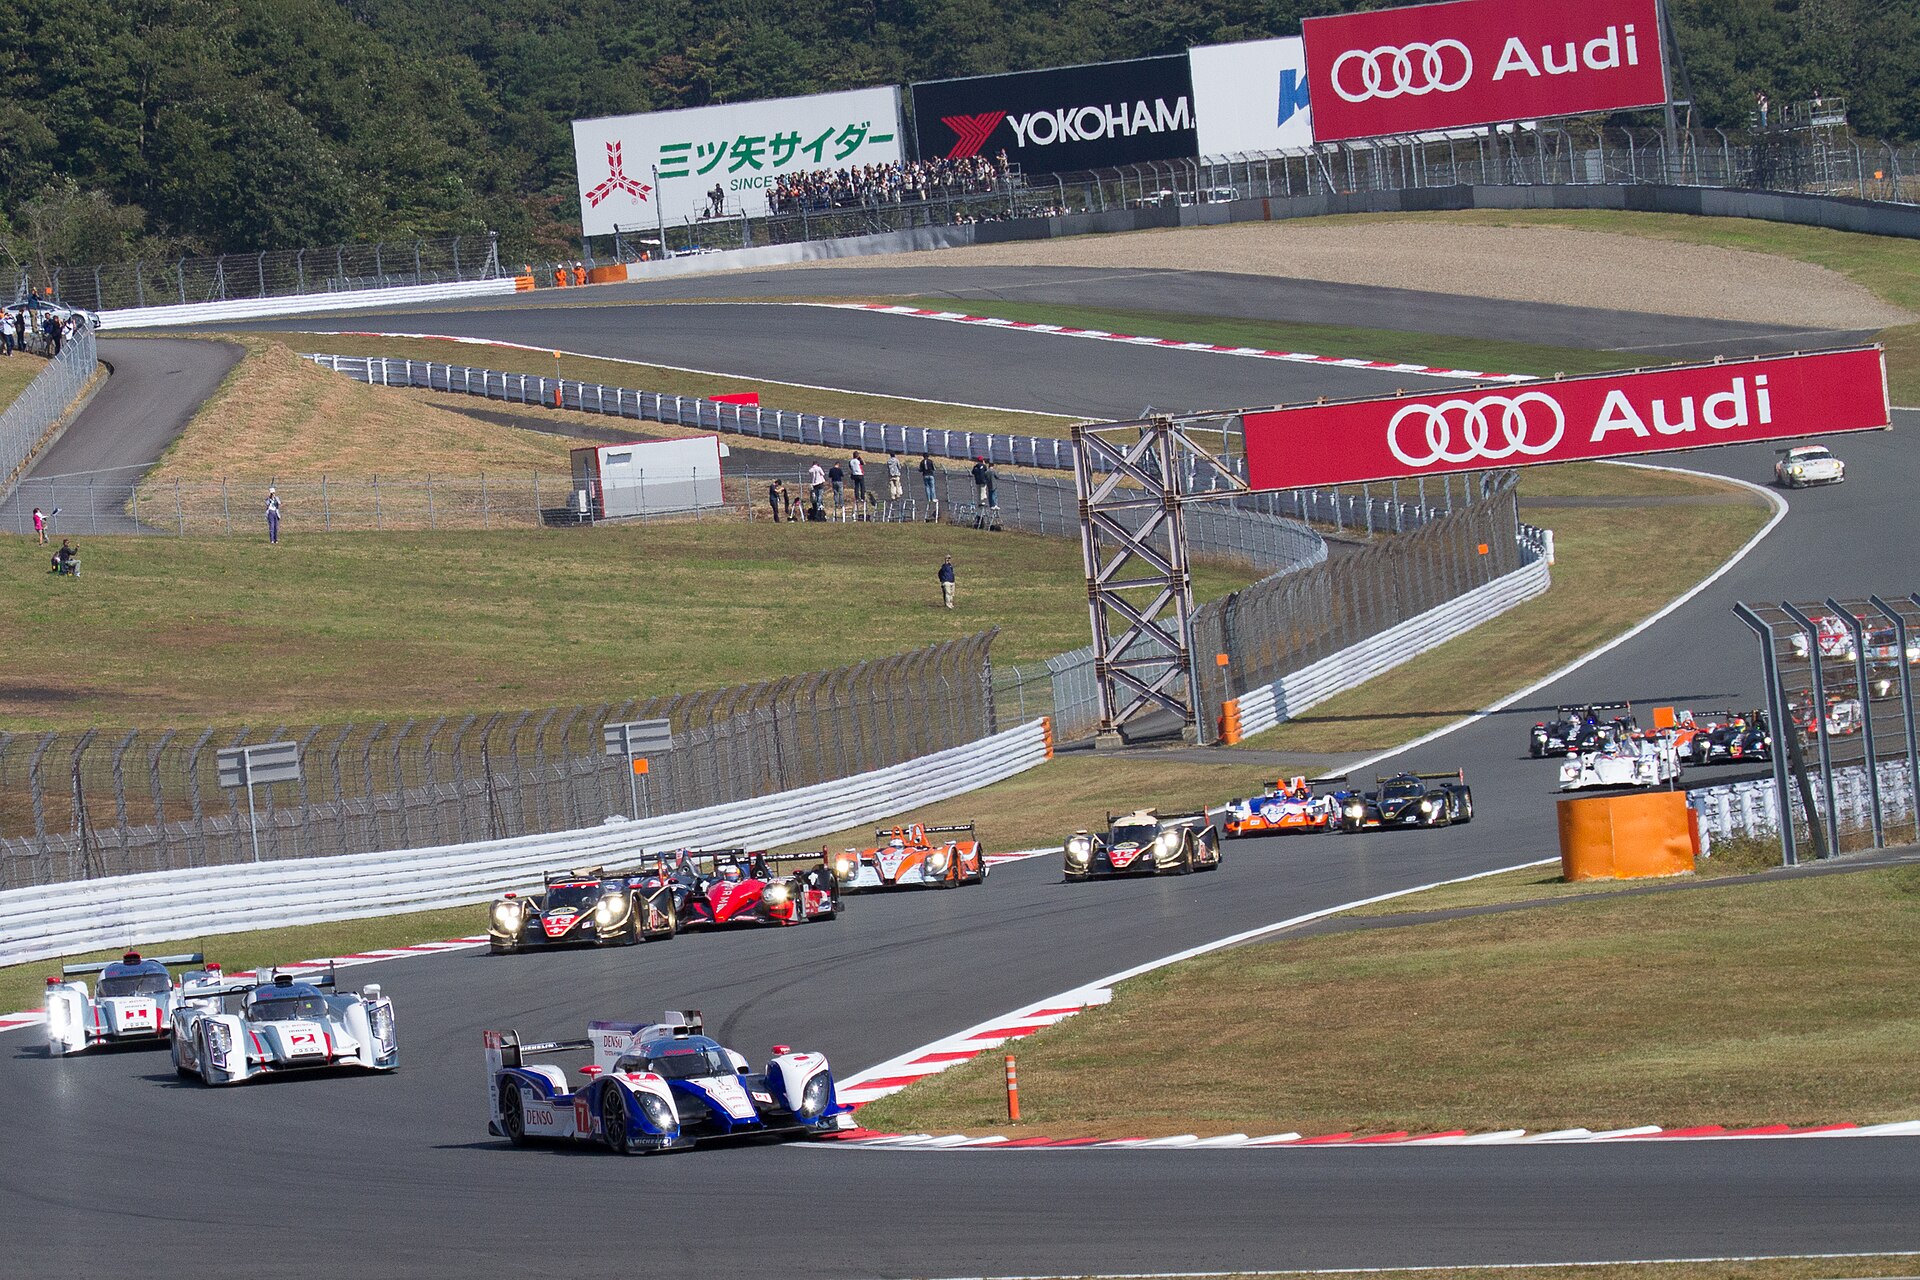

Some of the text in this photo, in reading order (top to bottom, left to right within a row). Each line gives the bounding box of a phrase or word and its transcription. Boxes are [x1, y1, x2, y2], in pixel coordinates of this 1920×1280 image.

[1492, 24, 1638, 80] Audi
[1006, 96, 1196, 147] YOKOHAM
[658, 121, 894, 178] 三ツ矢サイダー
[730, 175, 773, 191] SINCE
[1590, 374, 1772, 442] Audi
[603, 1035, 623, 1048] DENSO
[526, 1109, 554, 1125] DENSO
[579, 1107, 585, 1132] 7
